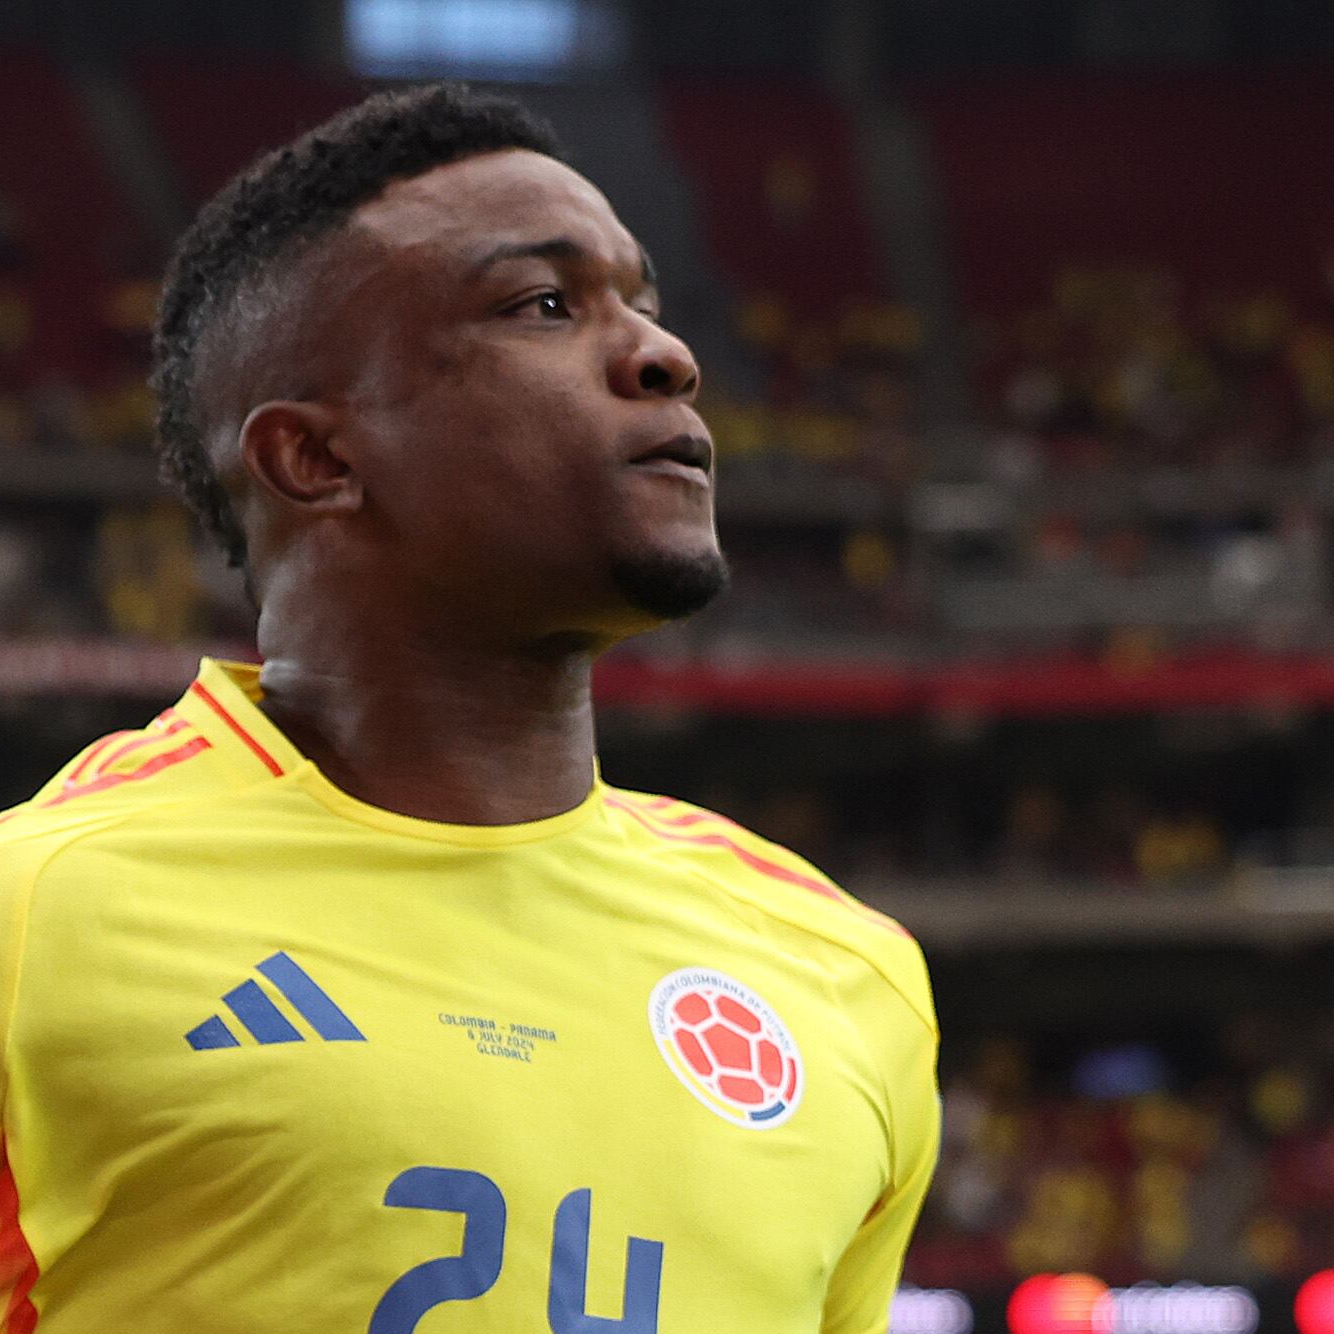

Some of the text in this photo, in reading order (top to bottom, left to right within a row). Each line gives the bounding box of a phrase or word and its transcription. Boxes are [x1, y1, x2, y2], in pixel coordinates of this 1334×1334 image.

[438, 1012, 496, 1031] COLOMBIA
[509, 1023, 557, 1042] PANAMA
[479, 1031, 503, 1043] JULY
[507, 1035, 535, 1050] 2024
[476, 1042, 532, 1063] GLENDALE
